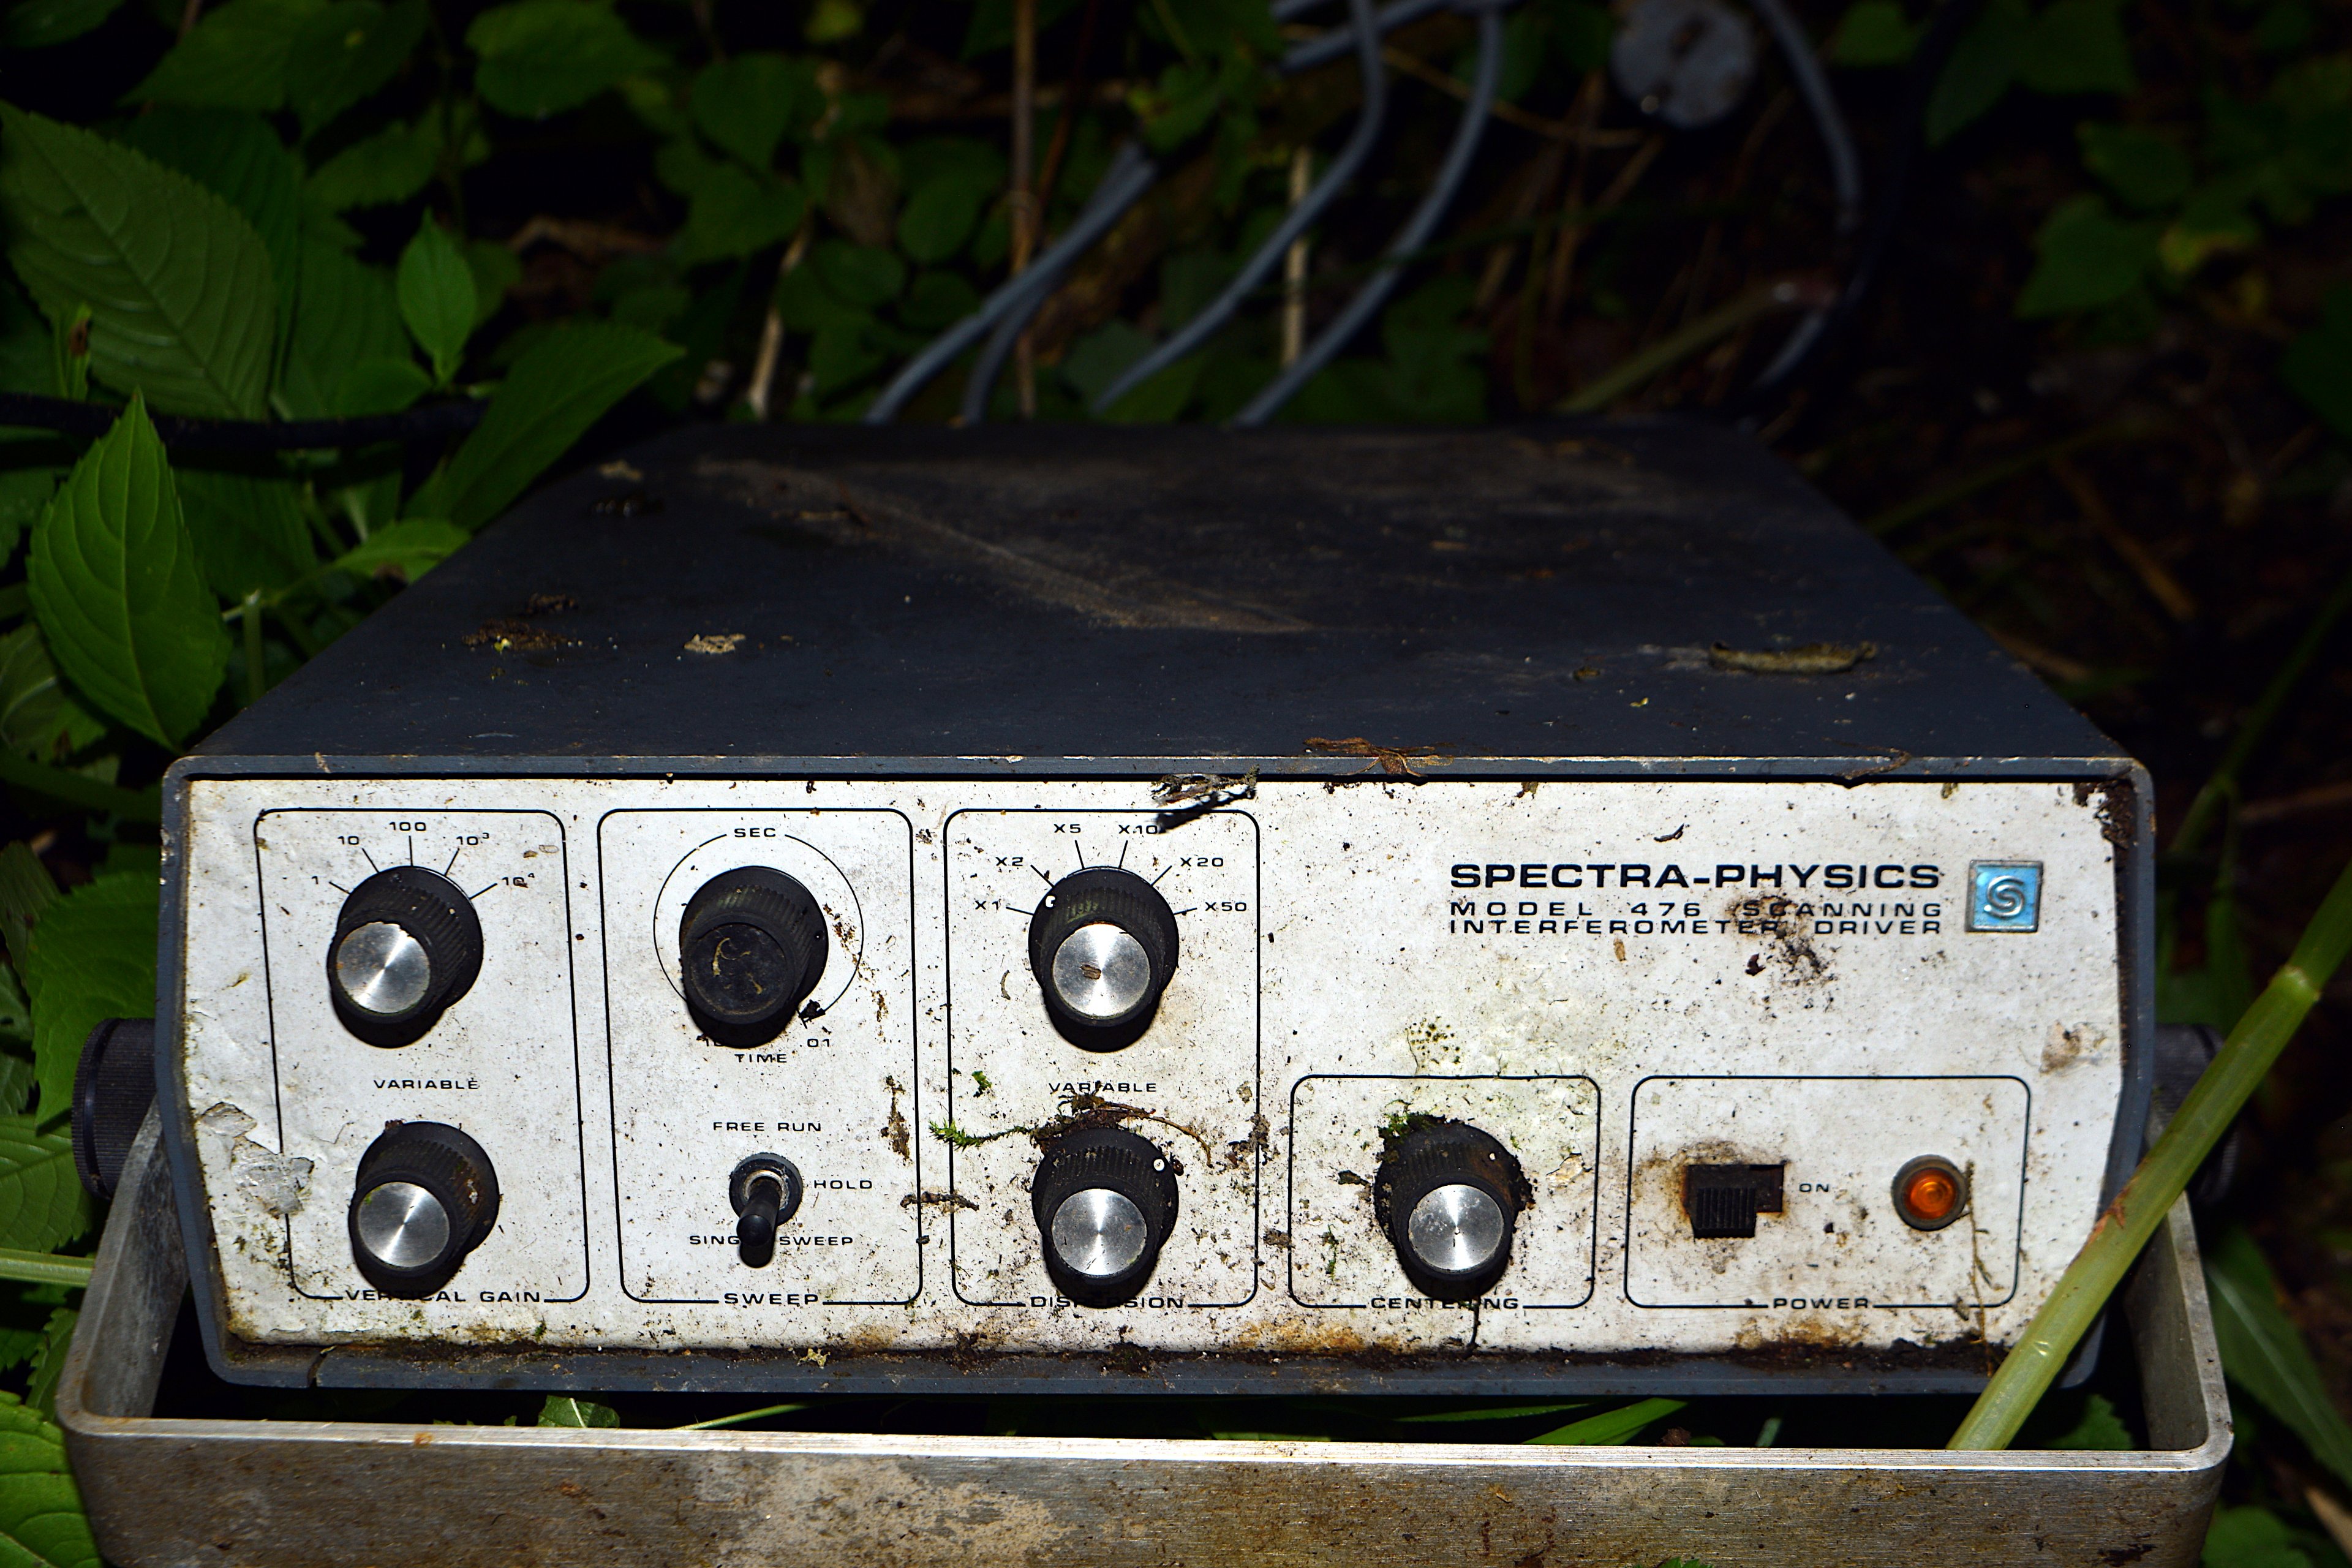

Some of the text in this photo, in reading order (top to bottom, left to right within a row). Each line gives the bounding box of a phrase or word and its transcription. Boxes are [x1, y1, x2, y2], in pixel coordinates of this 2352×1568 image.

[389, 822, 426, 832] 100
[1054, 824, 1080, 834] X5
[1118, 824, 1158, 835] X10
[734, 828, 776, 837] SEC
[337, 835, 359, 845] 10
[995, 857, 1023, 867] X2
[1180, 858, 1224, 867] X20
[312, 876, 318, 884] 1
[1451, 864, 1939, 888] SPECTRA-PHYSICS
[975, 900, 1000, 910] X1
[1205, 902, 1247, 911] X50
[1451, 900, 1941, 916] MODEL 476 SCANNING
[1450, 920, 1940, 934] INTERFEROMETER DRIVER
[734, 1054, 787, 1063] TIME
[374, 1079, 480, 1090] VARIABLE
[713, 1122, 821, 1131] FREE RUN
[814, 1180, 873, 1189] HOLD
[1799, 1183, 1829, 1193] ON
[690, 1235, 853, 1246] SING SWEEP
[345, 1289, 540, 1303] VERAL GAIN
[724, 1293, 819, 1305] SWEEP
[1030, 1296, 1183, 1308] DISSION
[1371, 1297, 1518, 1309] CENTENG
[1774, 1297, 1869, 1310] POWER
